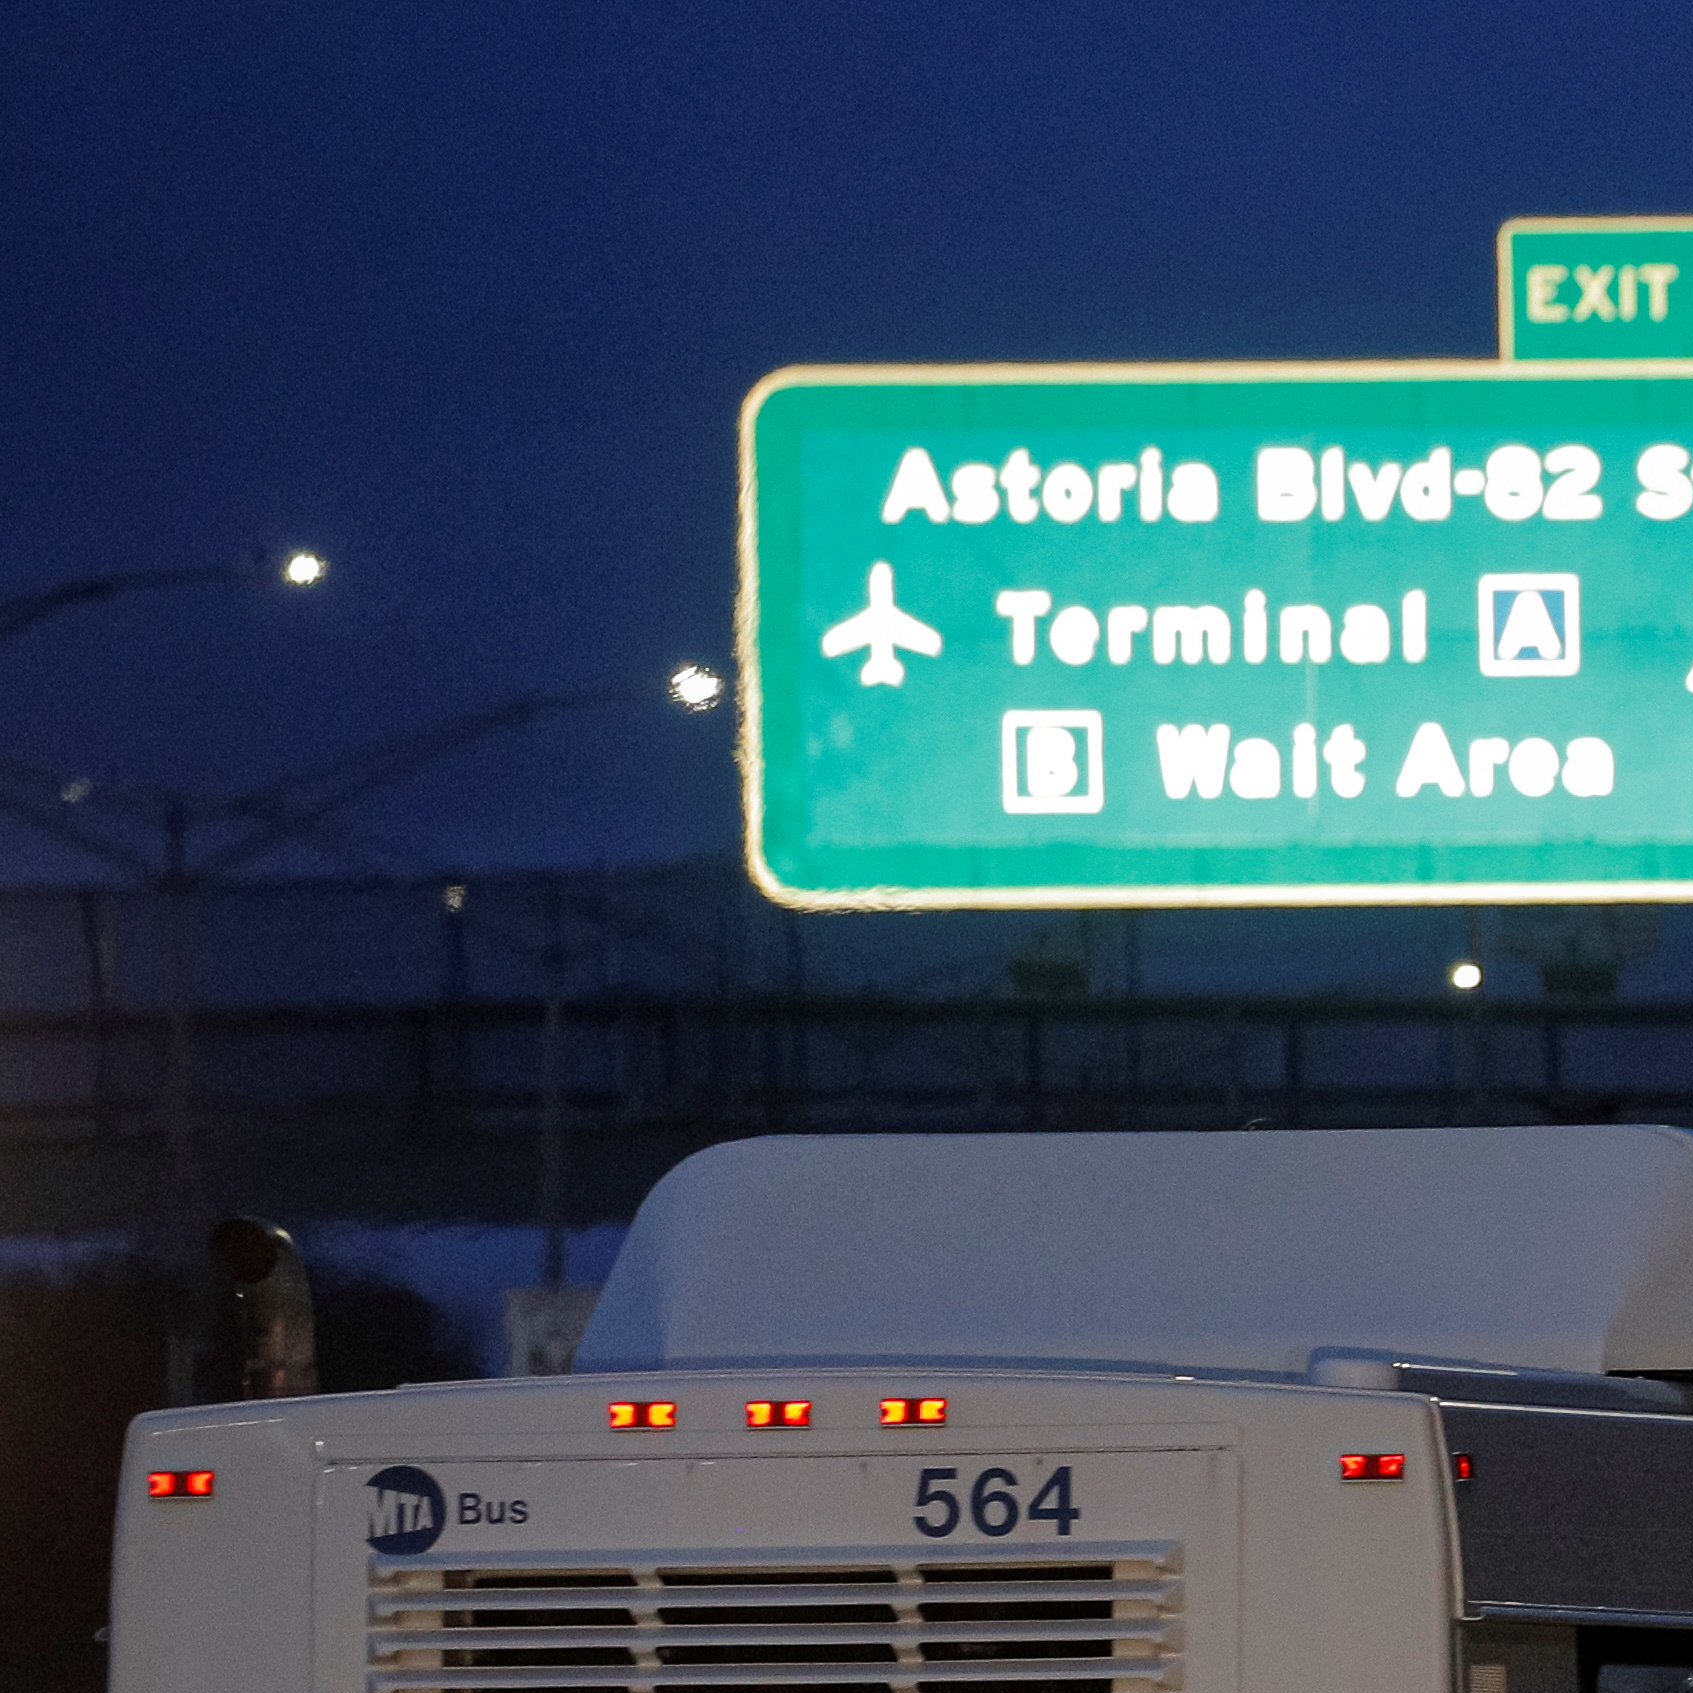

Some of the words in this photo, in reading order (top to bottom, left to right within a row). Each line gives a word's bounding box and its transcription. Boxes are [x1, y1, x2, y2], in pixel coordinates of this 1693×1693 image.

[1525, 263, 1680, 324] EXIT
[881, 446, 1220, 525] Astoria
[1257, 445, 1605, 523] Blvd-82
[996, 589, 1428, 666] Terminal
[1497, 591, 1563, 660] A
[1027, 727, 1078, 797] B
[1156, 723, 1367, 800] Wait
[1395, 722, 1616, 798] Area
[366, 1484, 434, 1540] MTA
[459, 1491, 528, 1525] Bus
[913, 1466, 1081, 1538] 564
